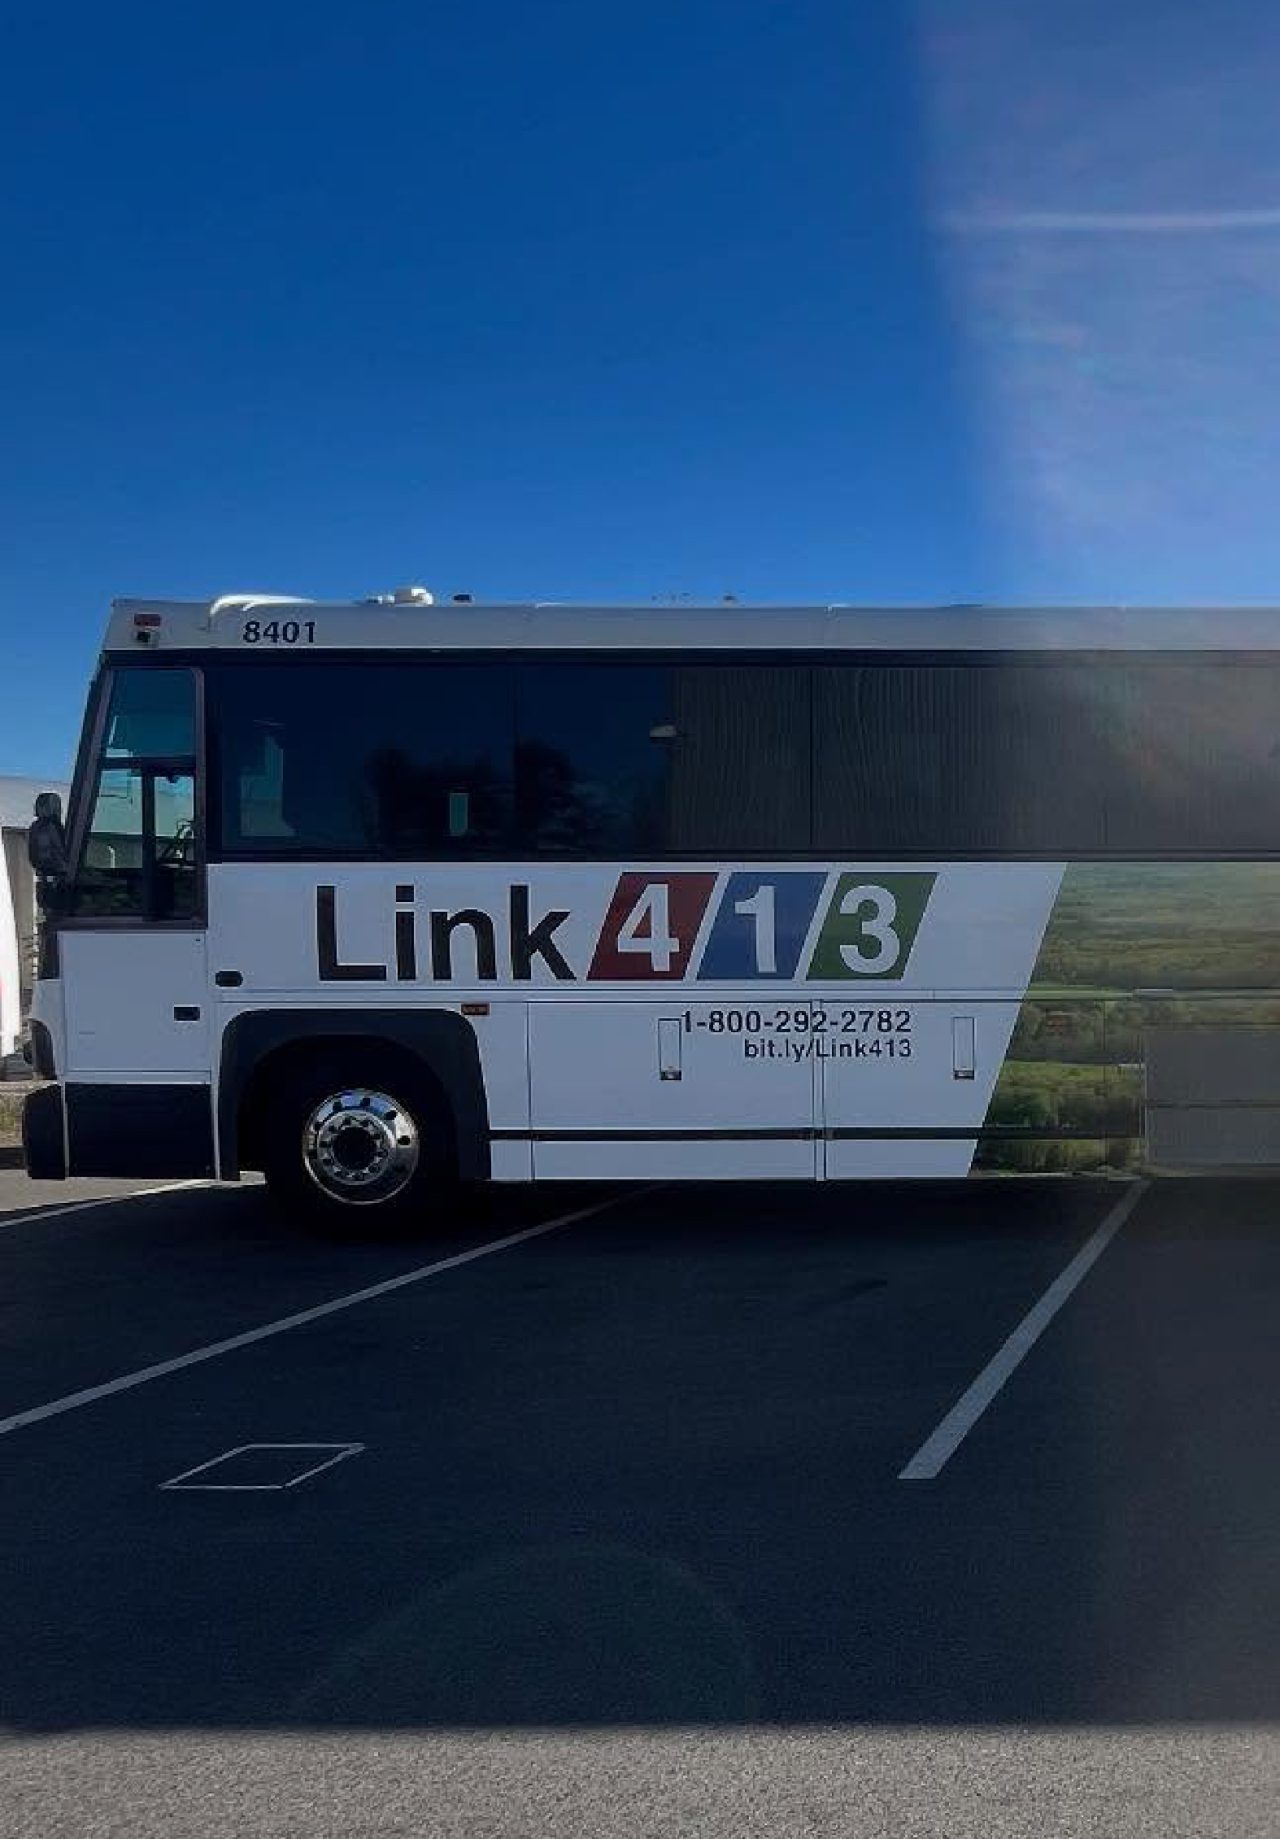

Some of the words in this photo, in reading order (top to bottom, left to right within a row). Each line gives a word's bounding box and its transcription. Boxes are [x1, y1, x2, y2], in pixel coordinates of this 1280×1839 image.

[243, 620, 316, 643] 8401
[681, 1010, 912, 1033] 1-800-292-2782
[744, 1038, 912, 1063] bit.ly/Link413
